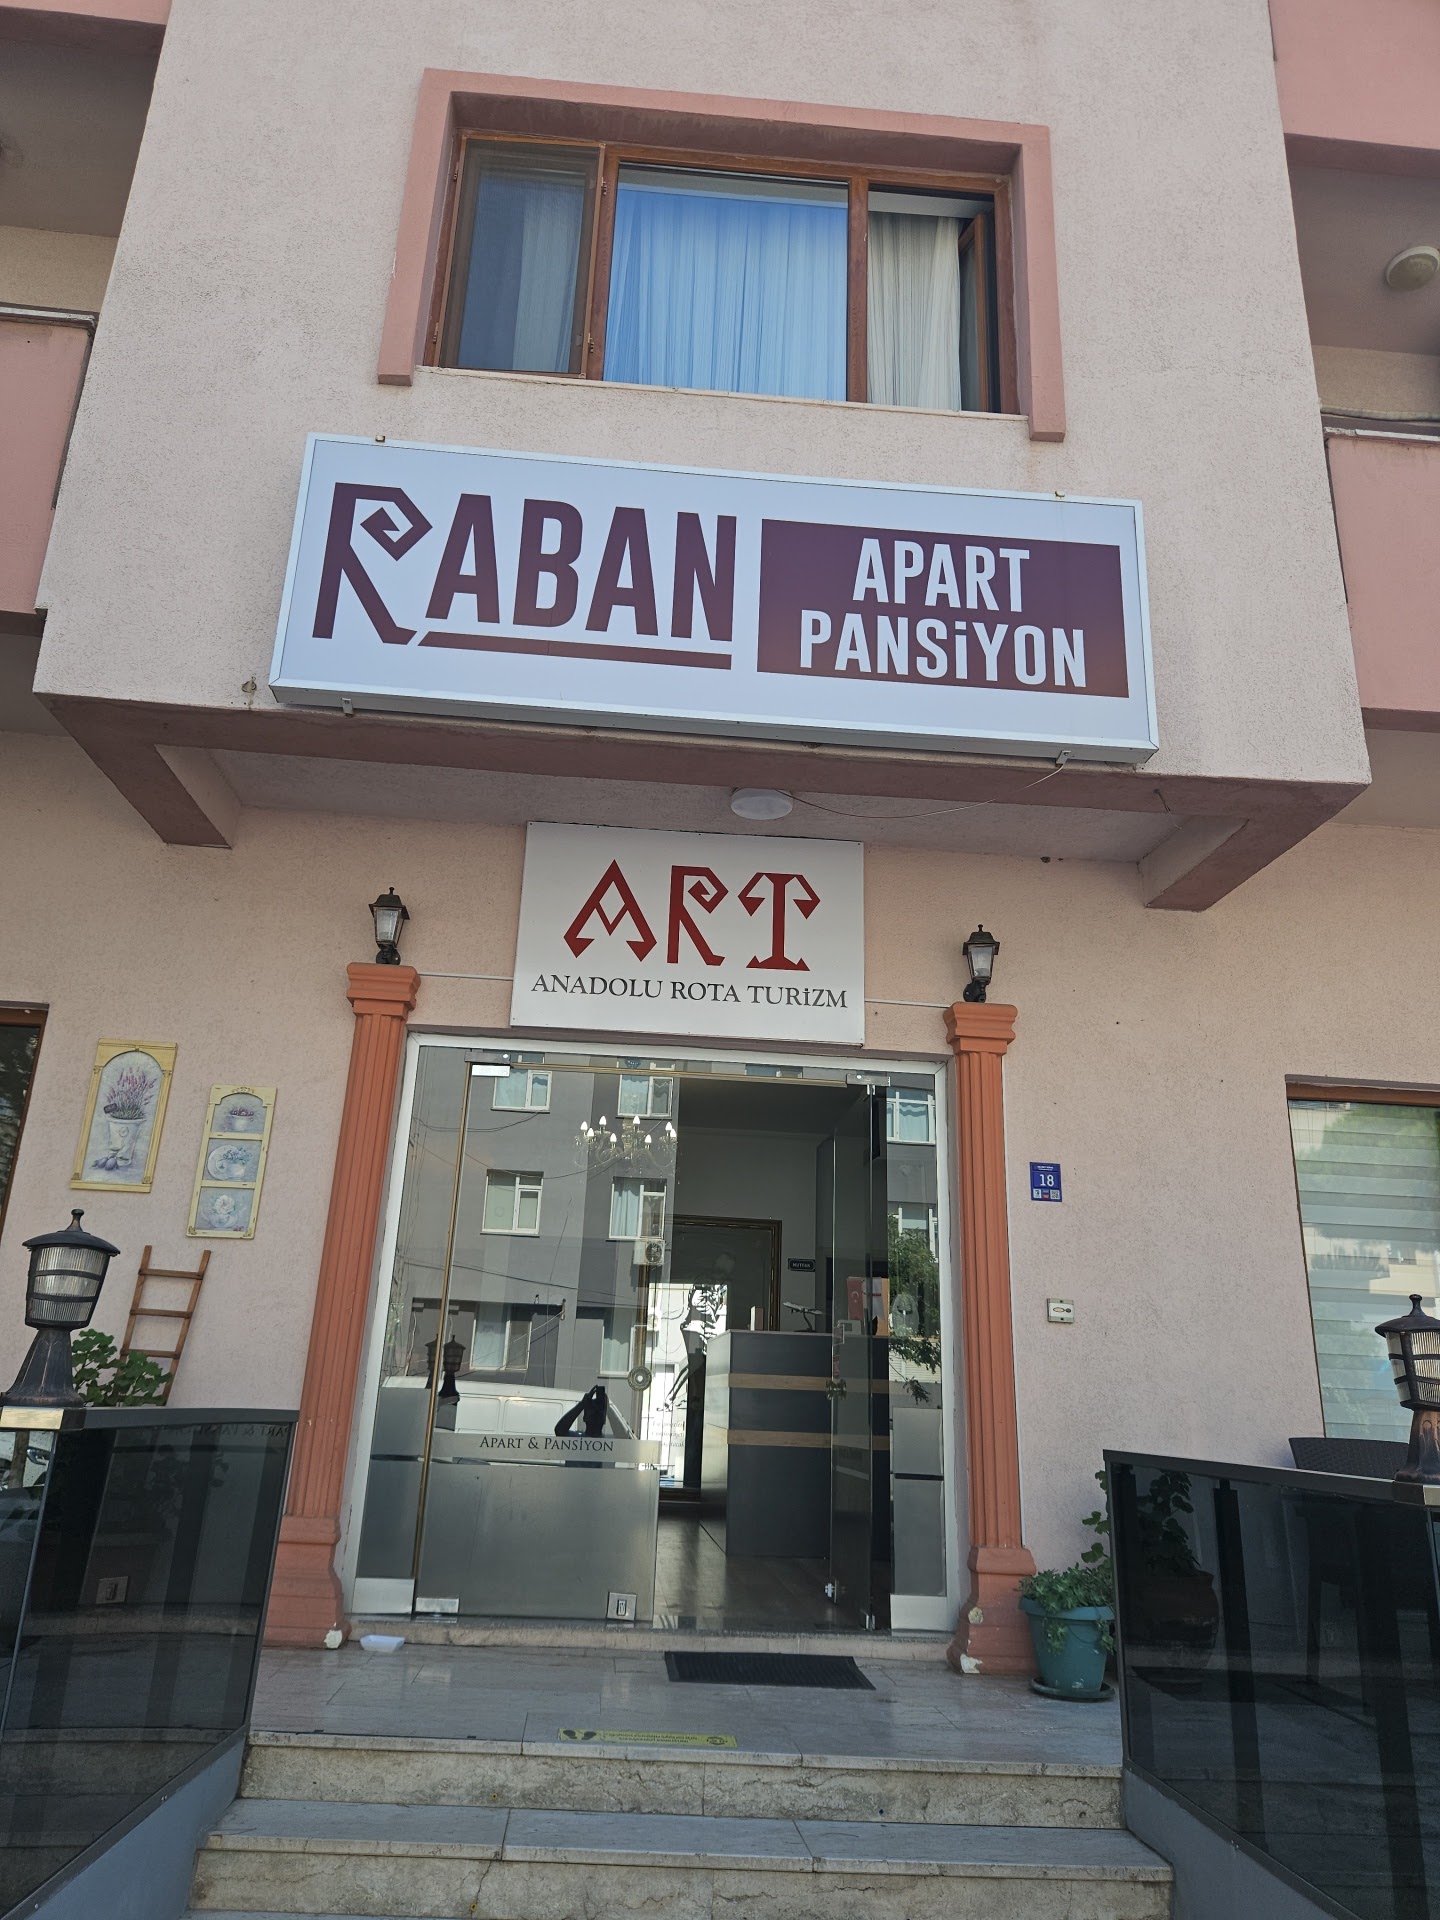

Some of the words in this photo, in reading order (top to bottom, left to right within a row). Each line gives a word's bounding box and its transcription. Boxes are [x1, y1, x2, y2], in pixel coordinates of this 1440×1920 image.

[312, 482, 736, 645] RABAN
[852, 537, 1030, 613] APART
[563, 859, 821, 972] ART
[531, 973, 664, 999] ANADOLU
[671, 981, 741, 1004] ROTA
[1039, 1173, 1055, 1188] 18
[479, 1435, 524, 1449] APART
[528, 1436, 539, 1450] &
